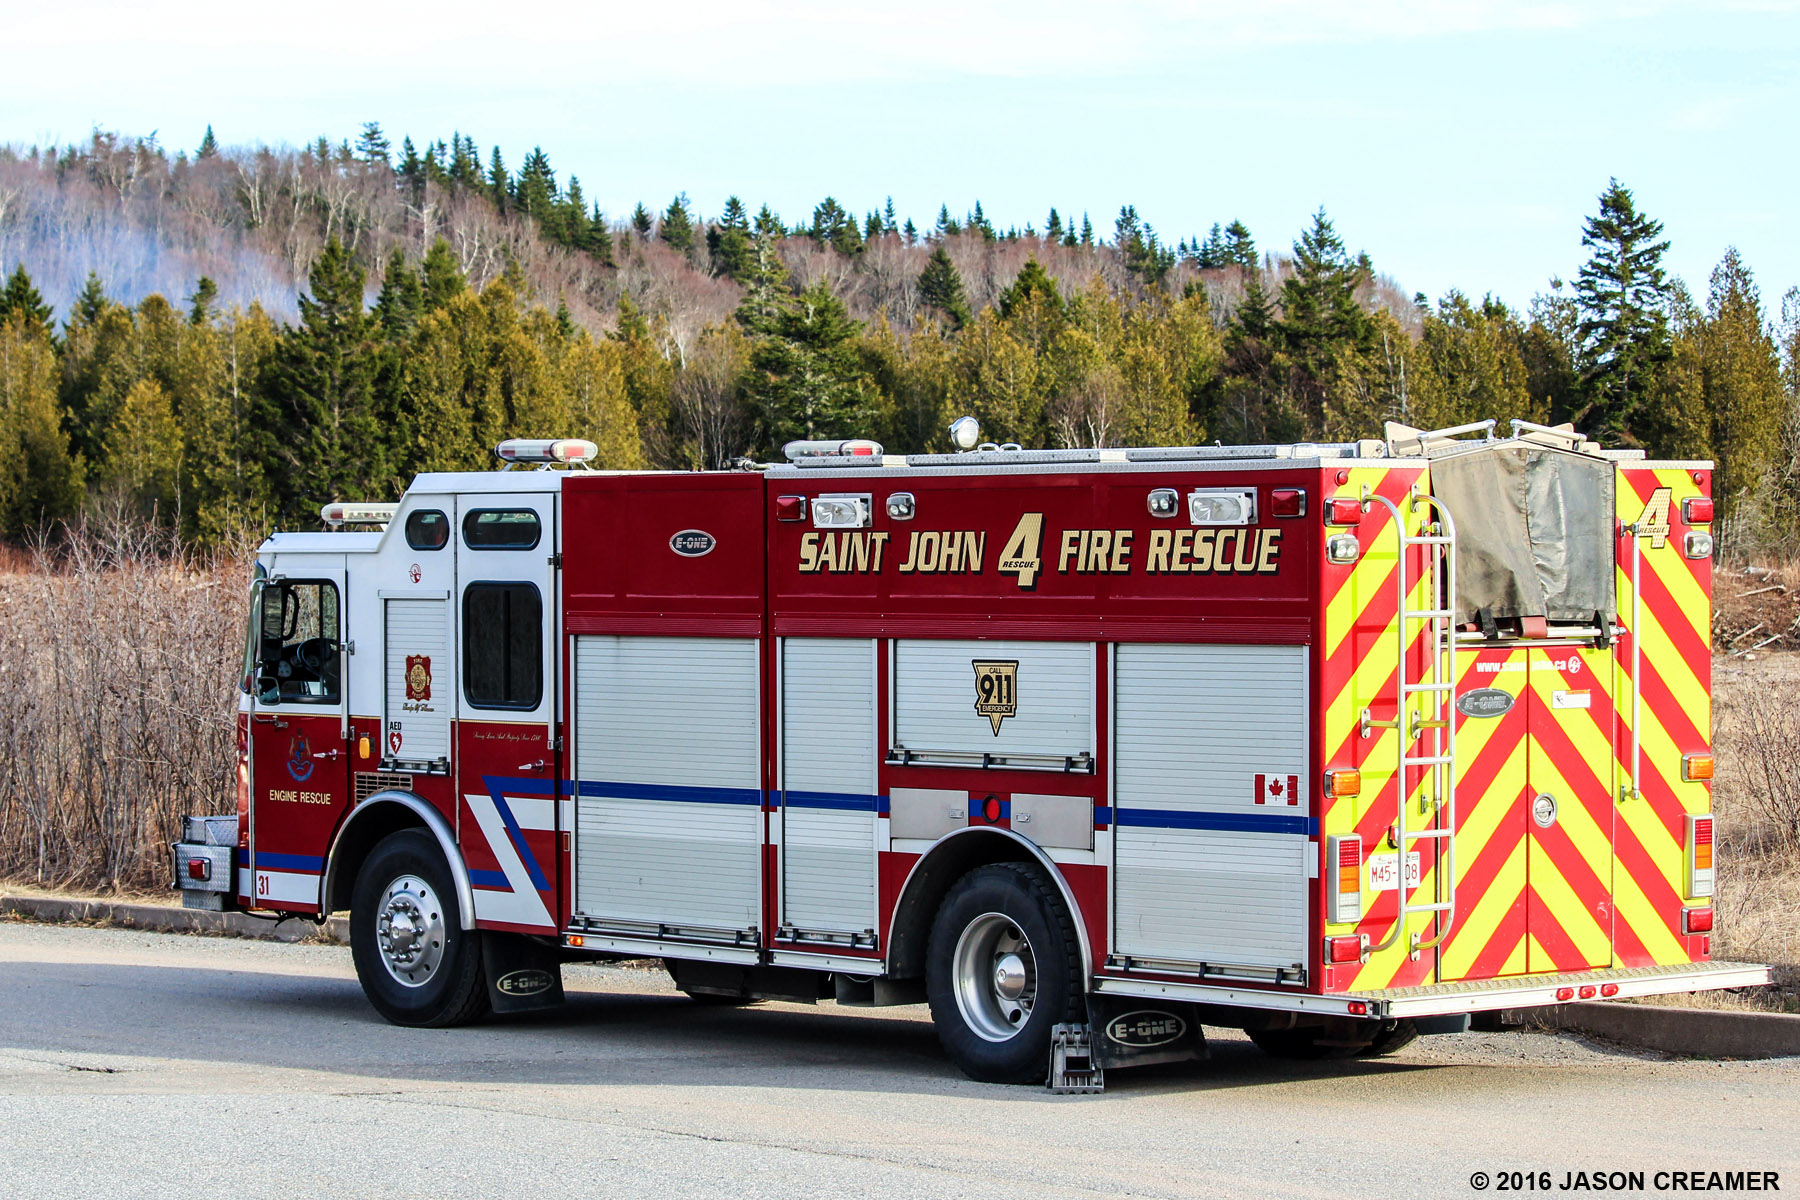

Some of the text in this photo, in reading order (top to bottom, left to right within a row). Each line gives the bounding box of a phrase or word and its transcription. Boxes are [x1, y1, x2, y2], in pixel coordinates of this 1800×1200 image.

[1635, 486, 1672, 549] 4
[675, 536, 709, 549] E-ONE
[799, 512, 1283, 590] SAINT JOHN 4 FIRE RESCUE
[1002, 560, 1036, 569] RESCUE
[1464, 695, 1507, 710] E-ONE
[389, 721, 402, 731] AED
[269, 789, 332, 805] ENGINE RESCUE
[1371, 863, 1418, 884] M45-08
[258, 875, 270, 896] 31
[1114, 1019, 1178, 1039] E-ONE
